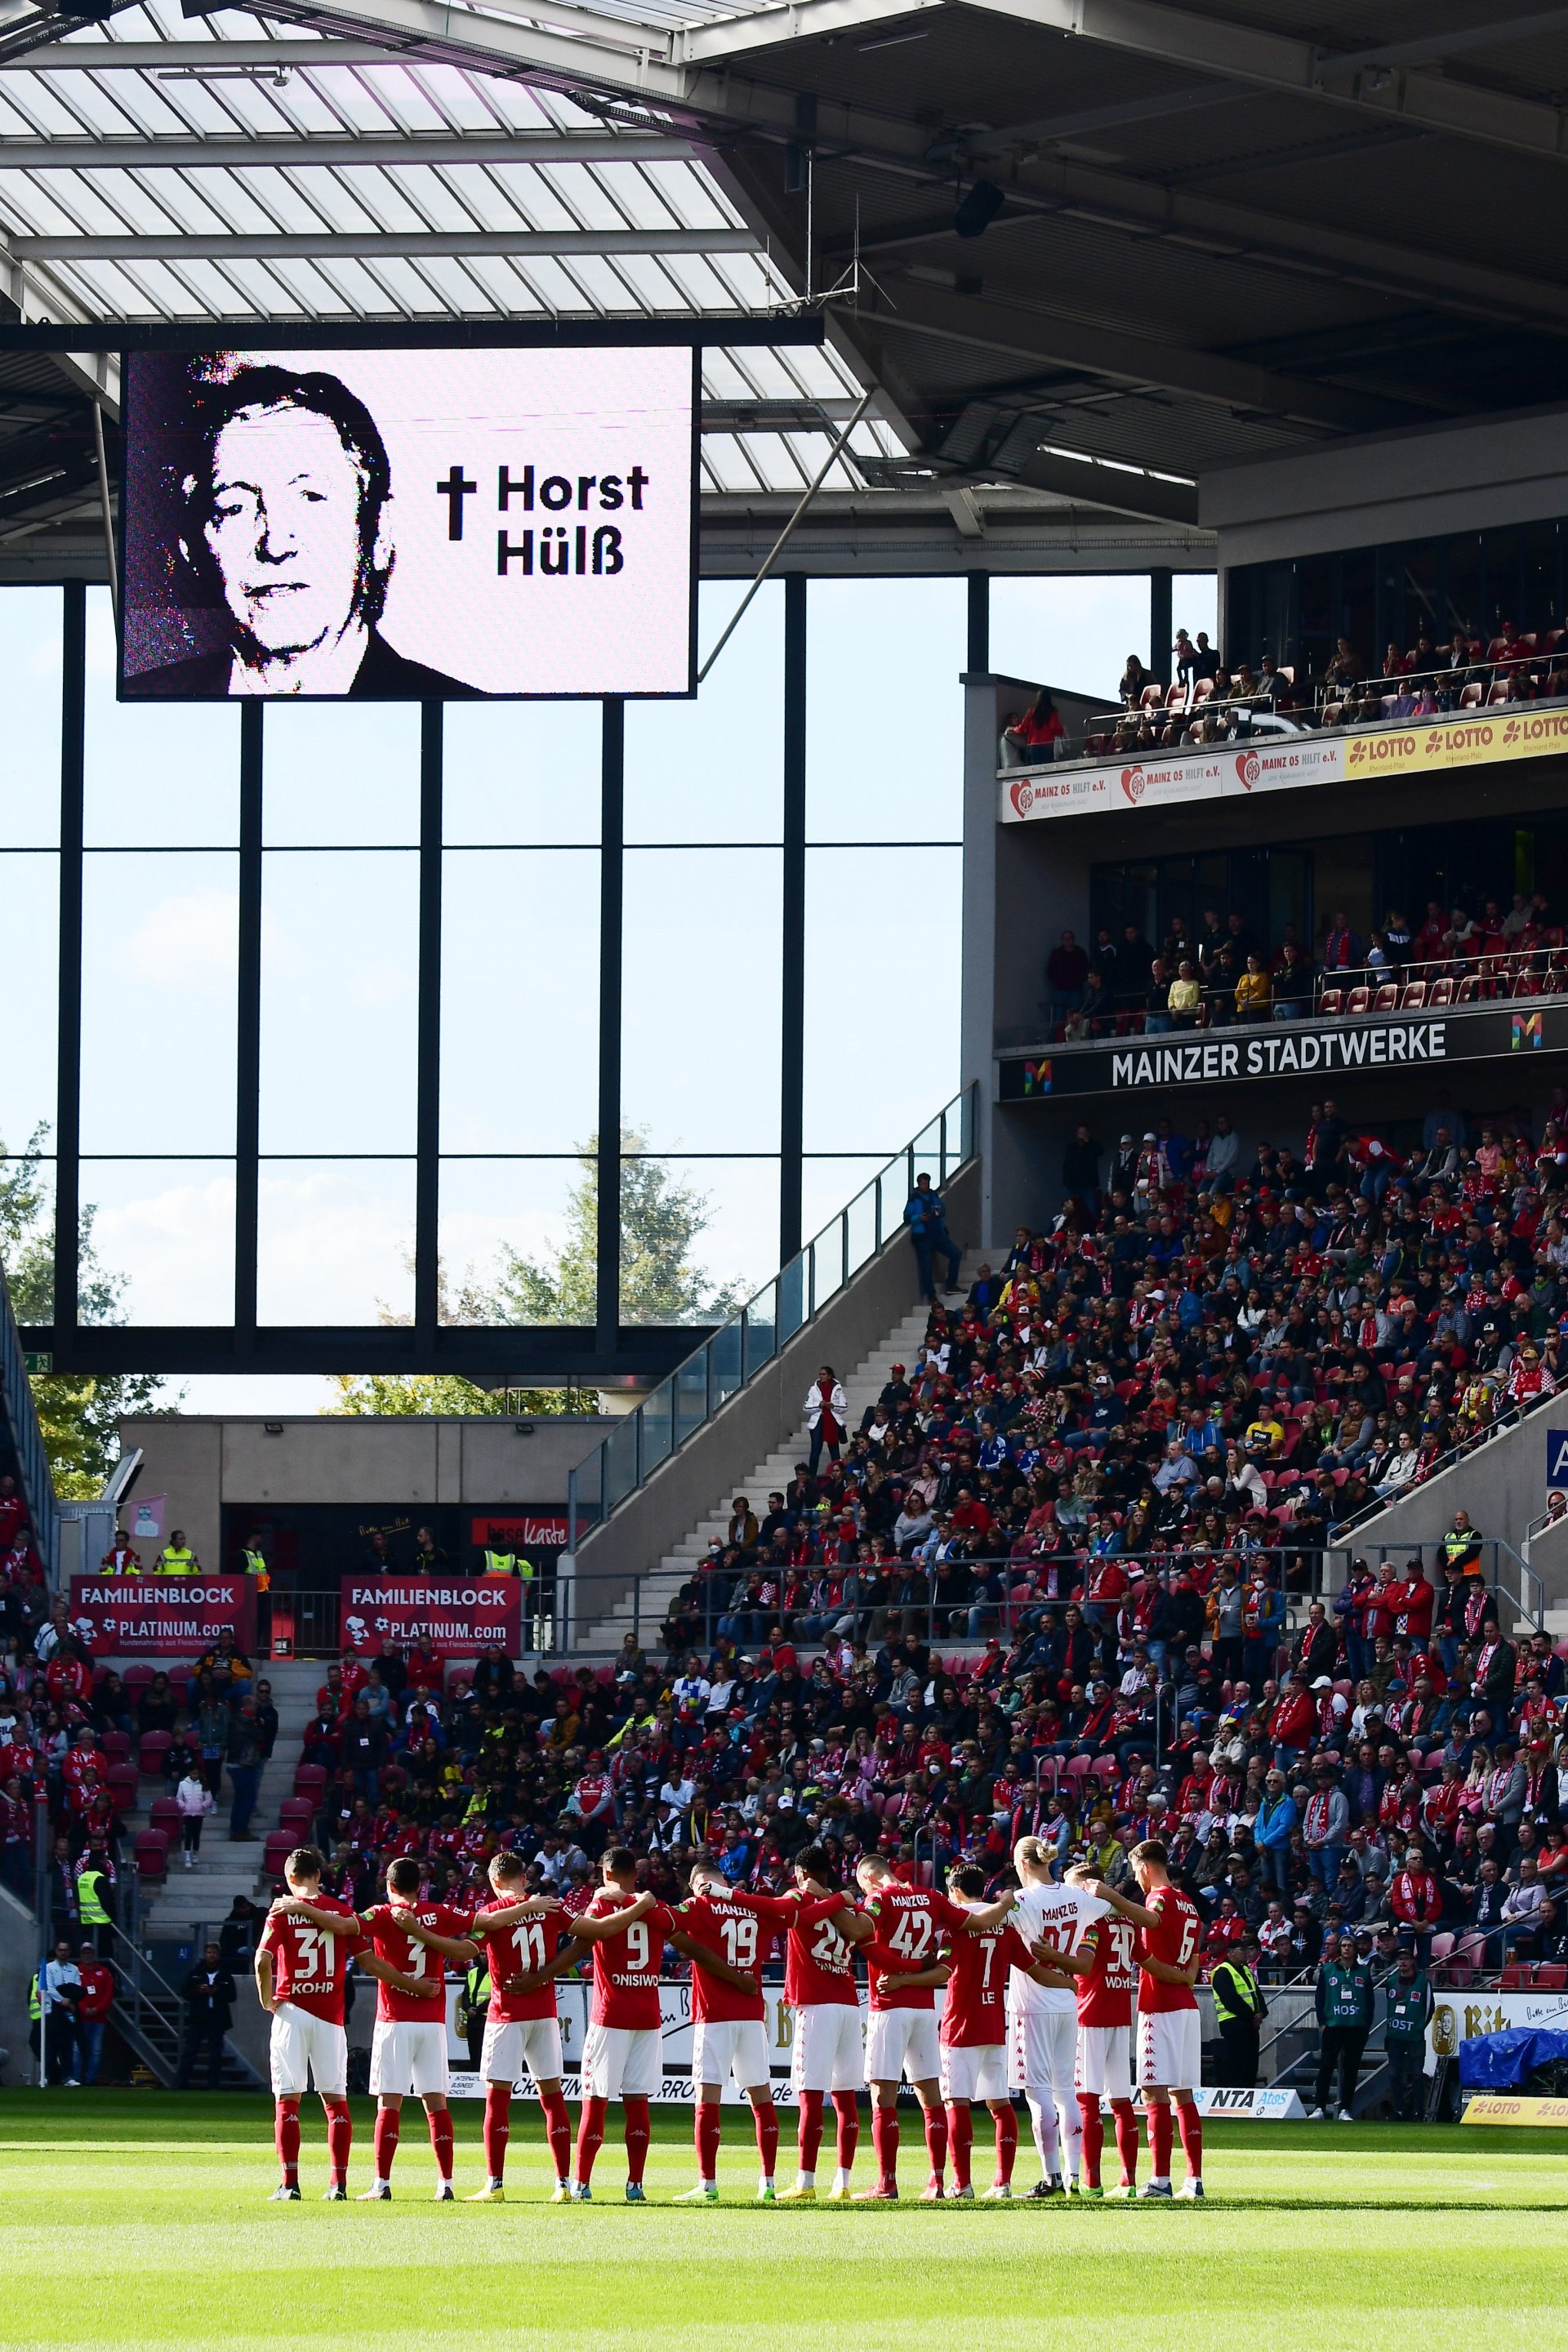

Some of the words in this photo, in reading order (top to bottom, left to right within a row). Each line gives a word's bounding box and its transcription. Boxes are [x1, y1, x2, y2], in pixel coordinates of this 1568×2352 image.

[498, 465, 649, 511] Horst
[497, 524, 624, 575] Hülß
[1370, 736, 1415, 760] LOTTO
[1446, 726, 1493, 751] LOTTO
[1262, 757, 1286, 770] MAINZ
[1290, 755, 1299, 766] 05
[1302, 752, 1321, 765] HILFT
[1323, 751, 1337, 762] e.V.
[1147, 771, 1171, 784] MAINZ
[1174, 770, 1183, 781] 05
[1186, 768, 1205, 780] HILFT
[1206, 765, 1220, 777] e.V.
[1035, 786, 1058, 799] MAINZ
[1061, 784, 1071, 795] 05
[1072, 782, 1090, 794] HILFT
[1093, 780, 1106, 791] e.V.
[1112, 1044, 1239, 1086] MAINZER
[1246, 1023, 1446, 1074] STADTWERKE
[81, 1587, 234, 1604] FAMILIENBLOCK
[352, 1588, 506, 1606] FAMILIENBLOCK
[390, 1622, 506, 1638] PLATINUM.com
[627, 1921, 649, 1970] 9
[720, 1918, 758, 1967] 19
[889, 1910, 933, 1959] 42
[1177, 1918, 1198, 1964] 6
[294, 1928, 335, 1979] 31
[403, 1935, 426, 1980] 3
[511, 1923, 546, 1972] 11
[980, 1938, 996, 1989] 7
[292, 1982, 334, 1994] KOHR
[612, 1973, 659, 1987] ONISIWO
[1333, 2004, 1360, 2016] HOST
[1526, 2007, 1544, 2020] Bitte
[1210, 2090, 1255, 2108] NTA
[1487, 2102, 1521, 2114] LOTTO
